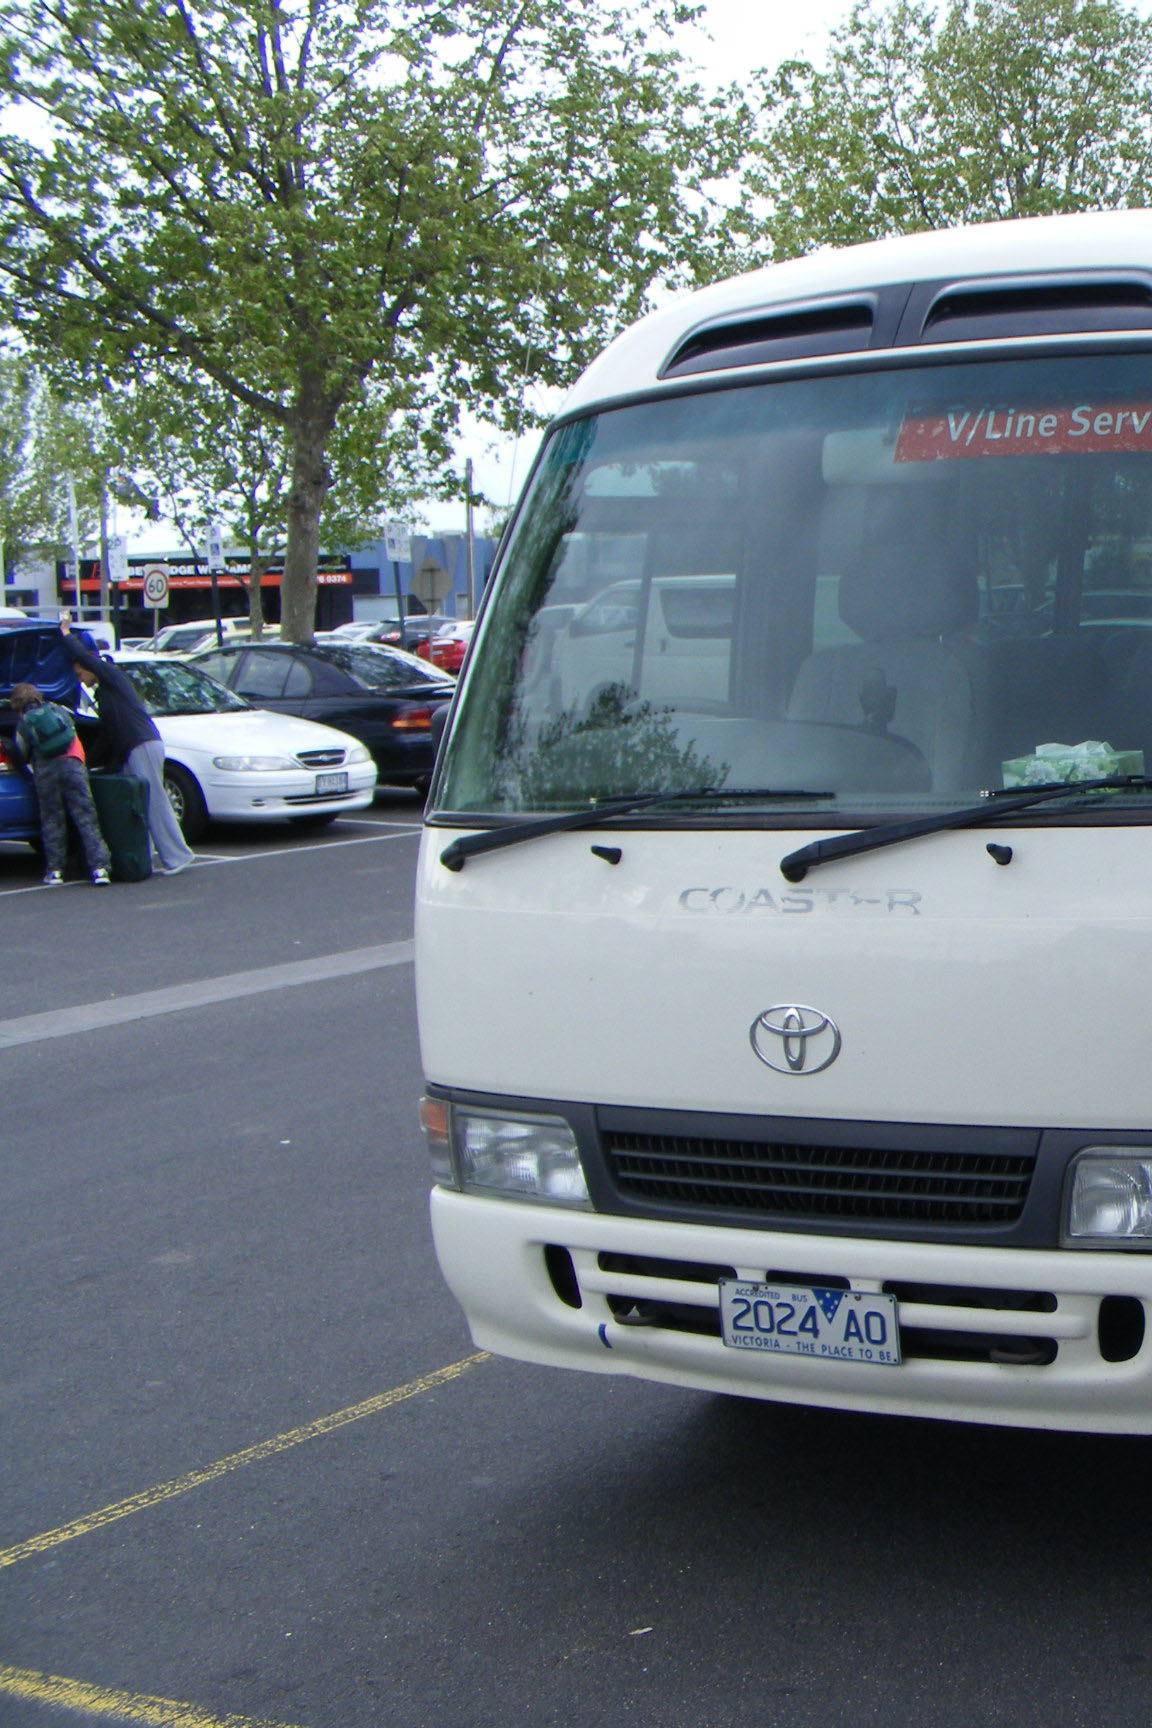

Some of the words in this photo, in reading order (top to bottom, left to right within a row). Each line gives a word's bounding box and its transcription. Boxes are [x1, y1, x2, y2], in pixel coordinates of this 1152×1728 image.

[946, 408, 1058, 447] V/Line
[148, 579, 163, 593] 60
[735, 1288, 780, 1300] ACCREDITED
[792, 1293, 808, 1303] BUS
[731, 1297, 820, 1339] 2024
[731, 1334, 781, 1349] VICTORIA
[796, 1341, 816, 1353] THE
[821, 1343, 853, 1357] PLACE
[859, 1348, 873, 1359] TO
[879, 1351, 892, 1361] BE
